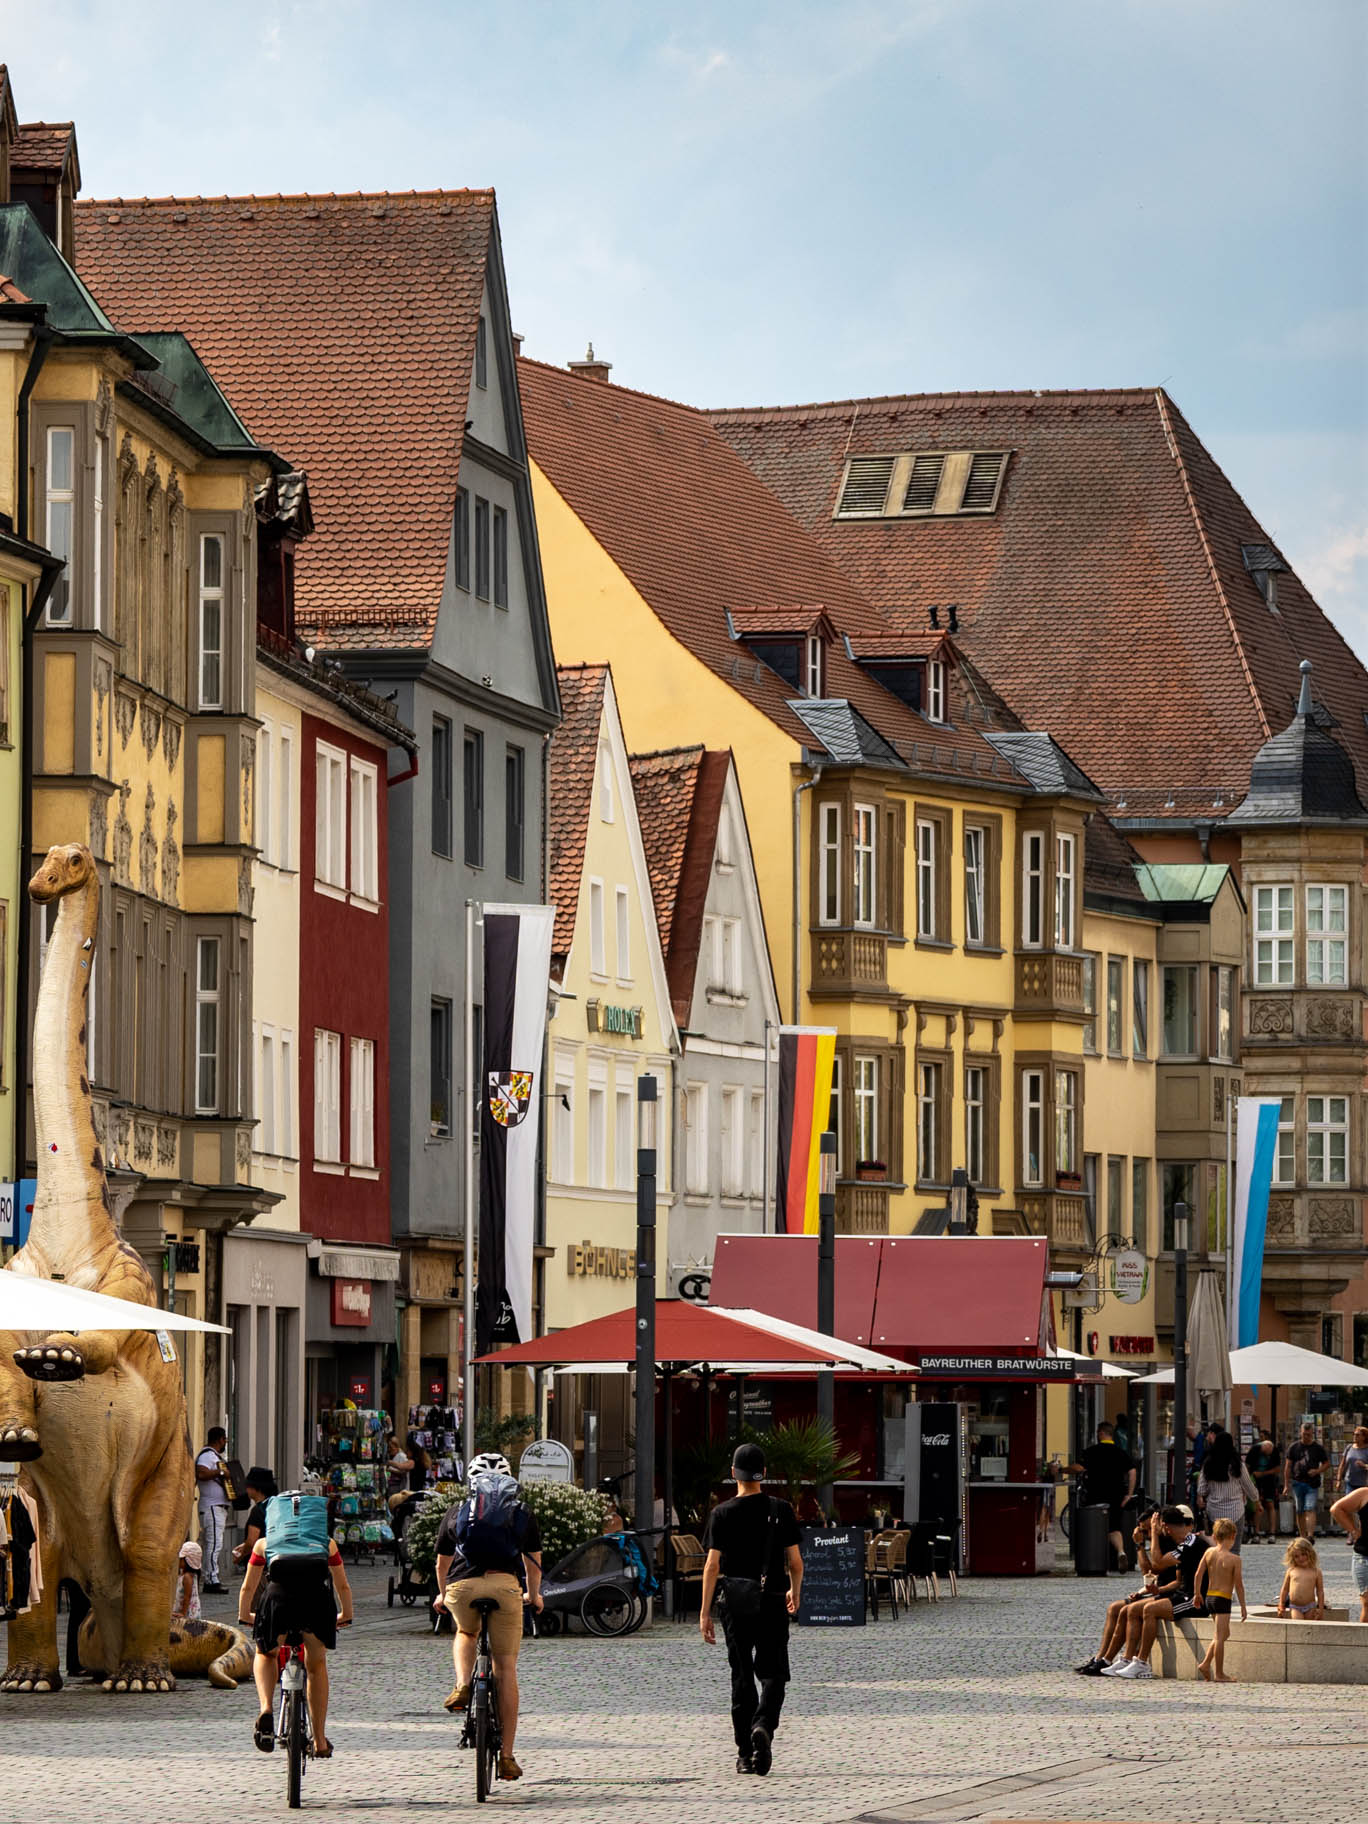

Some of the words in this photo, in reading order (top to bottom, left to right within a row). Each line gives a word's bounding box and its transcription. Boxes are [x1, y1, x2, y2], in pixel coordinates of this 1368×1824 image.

[921, 1358, 993, 1369] BAYREUTHER
[997, 1358, 1072, 1370] BRATWÜRSTE
[813, 1534, 850, 1548] Proviant
